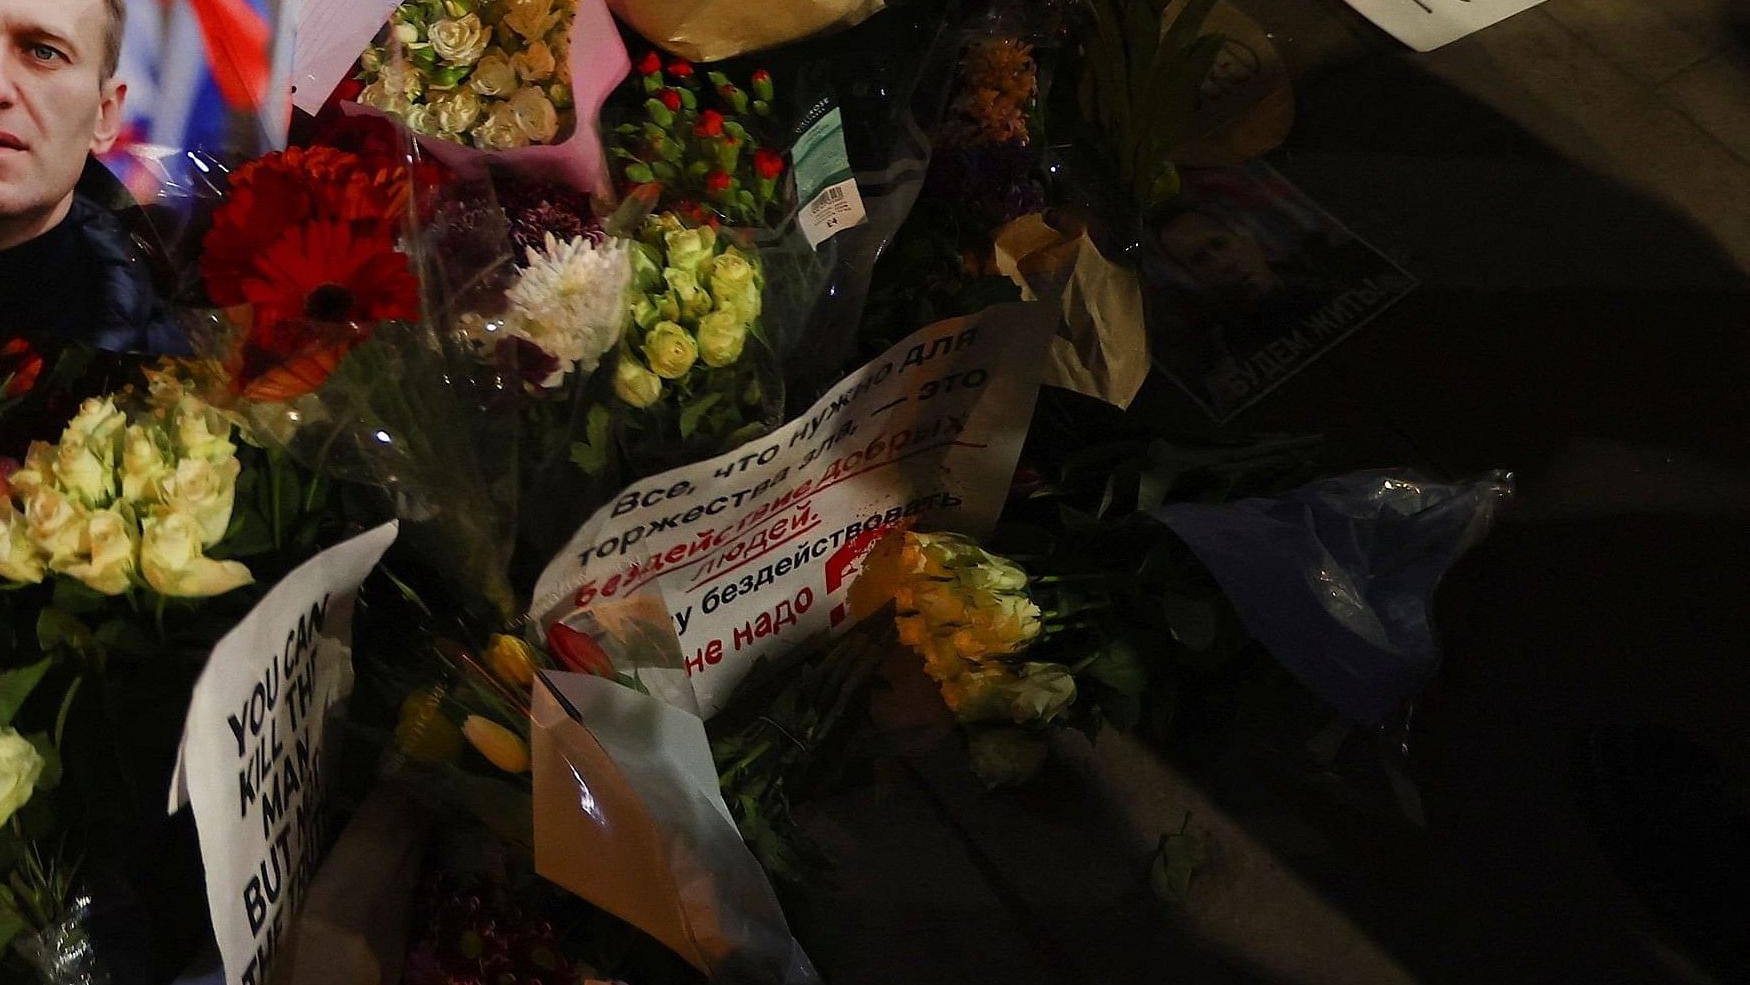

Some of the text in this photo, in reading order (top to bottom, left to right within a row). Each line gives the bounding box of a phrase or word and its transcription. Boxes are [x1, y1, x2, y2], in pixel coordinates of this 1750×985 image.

[578, 464, 792, 568] торжества
[918, 366, 989, 401] это
[610, 326, 978, 520] Все, что нужно для
[574, 413, 964, 608] бездействие добрых
[701, 490, 963, 617] бездействовать
[227, 593, 330, 758] YOU CAN
[685, 638, 724, 678] не
[733, 586, 815, 652] надо
[240, 718, 283, 822] KILL
[262, 726, 310, 842] MAN
[243, 822, 291, 940] BUT
